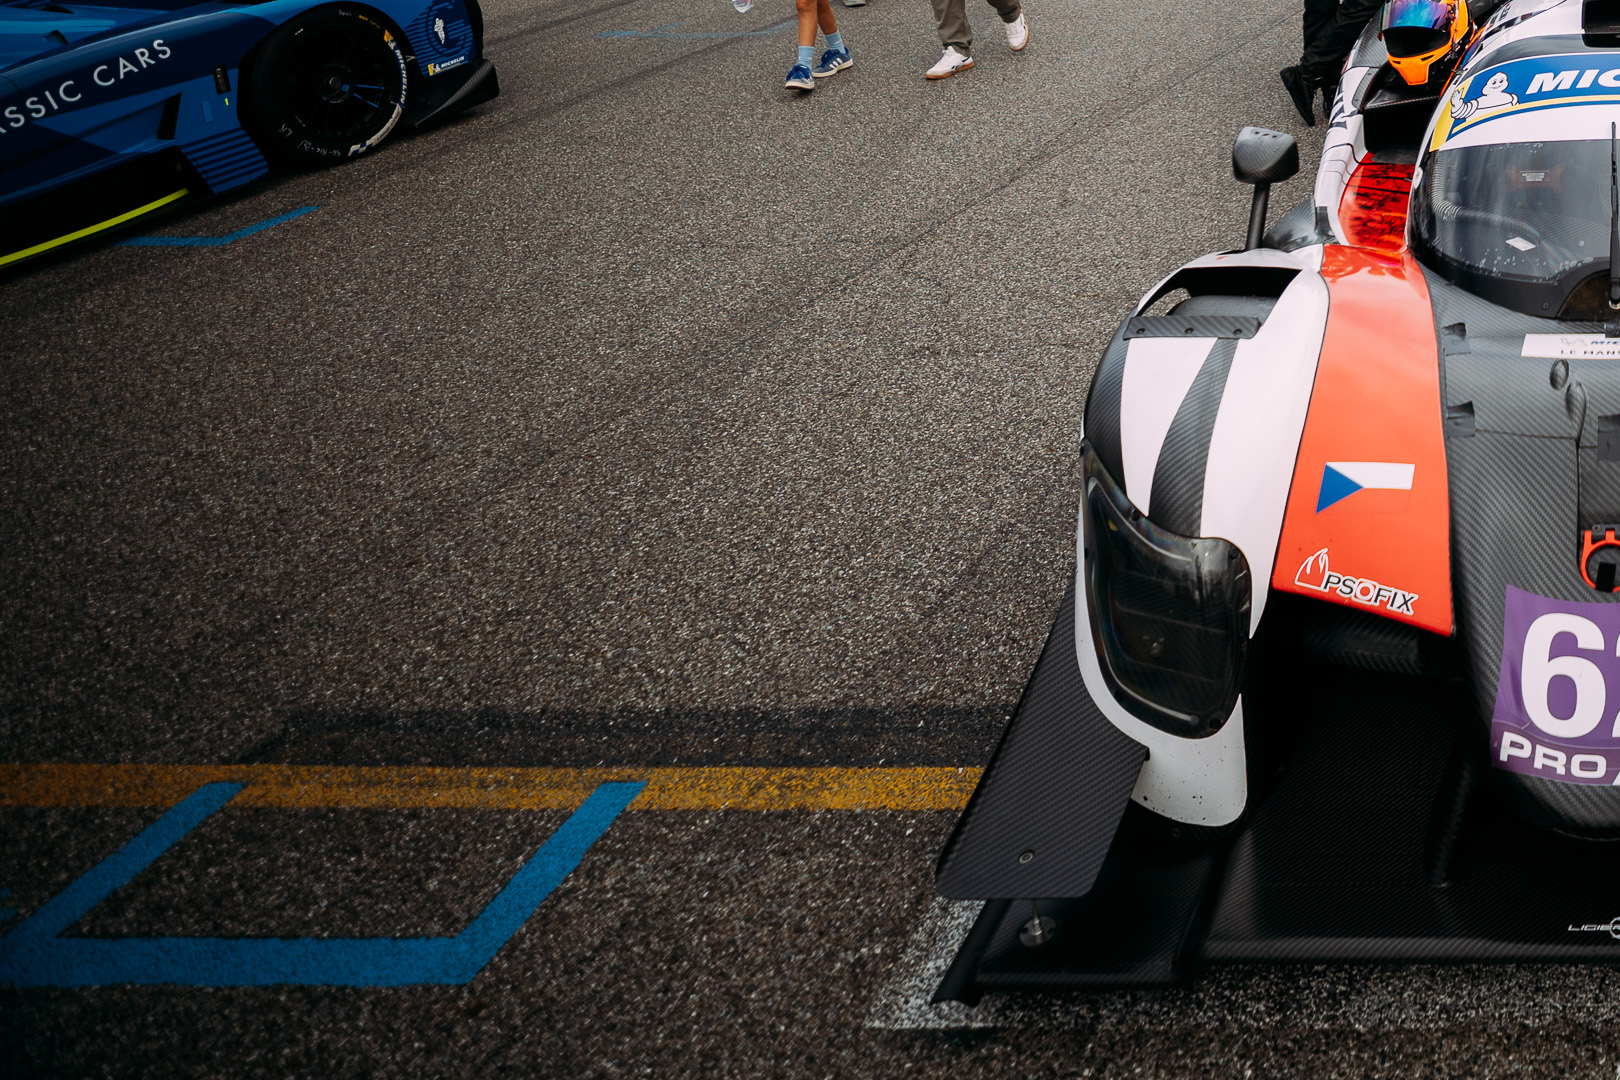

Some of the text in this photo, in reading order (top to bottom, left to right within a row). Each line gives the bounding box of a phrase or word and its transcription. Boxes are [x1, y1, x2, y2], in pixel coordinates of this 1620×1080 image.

[92, 38, 173, 88] CARS
[395, 48, 409, 105] MICHELIN
[440, 55, 465, 69] MICHELIN
[1321, 572, 1420, 617] PSOFIX
[1500, 730, 1607, 779] PRO
